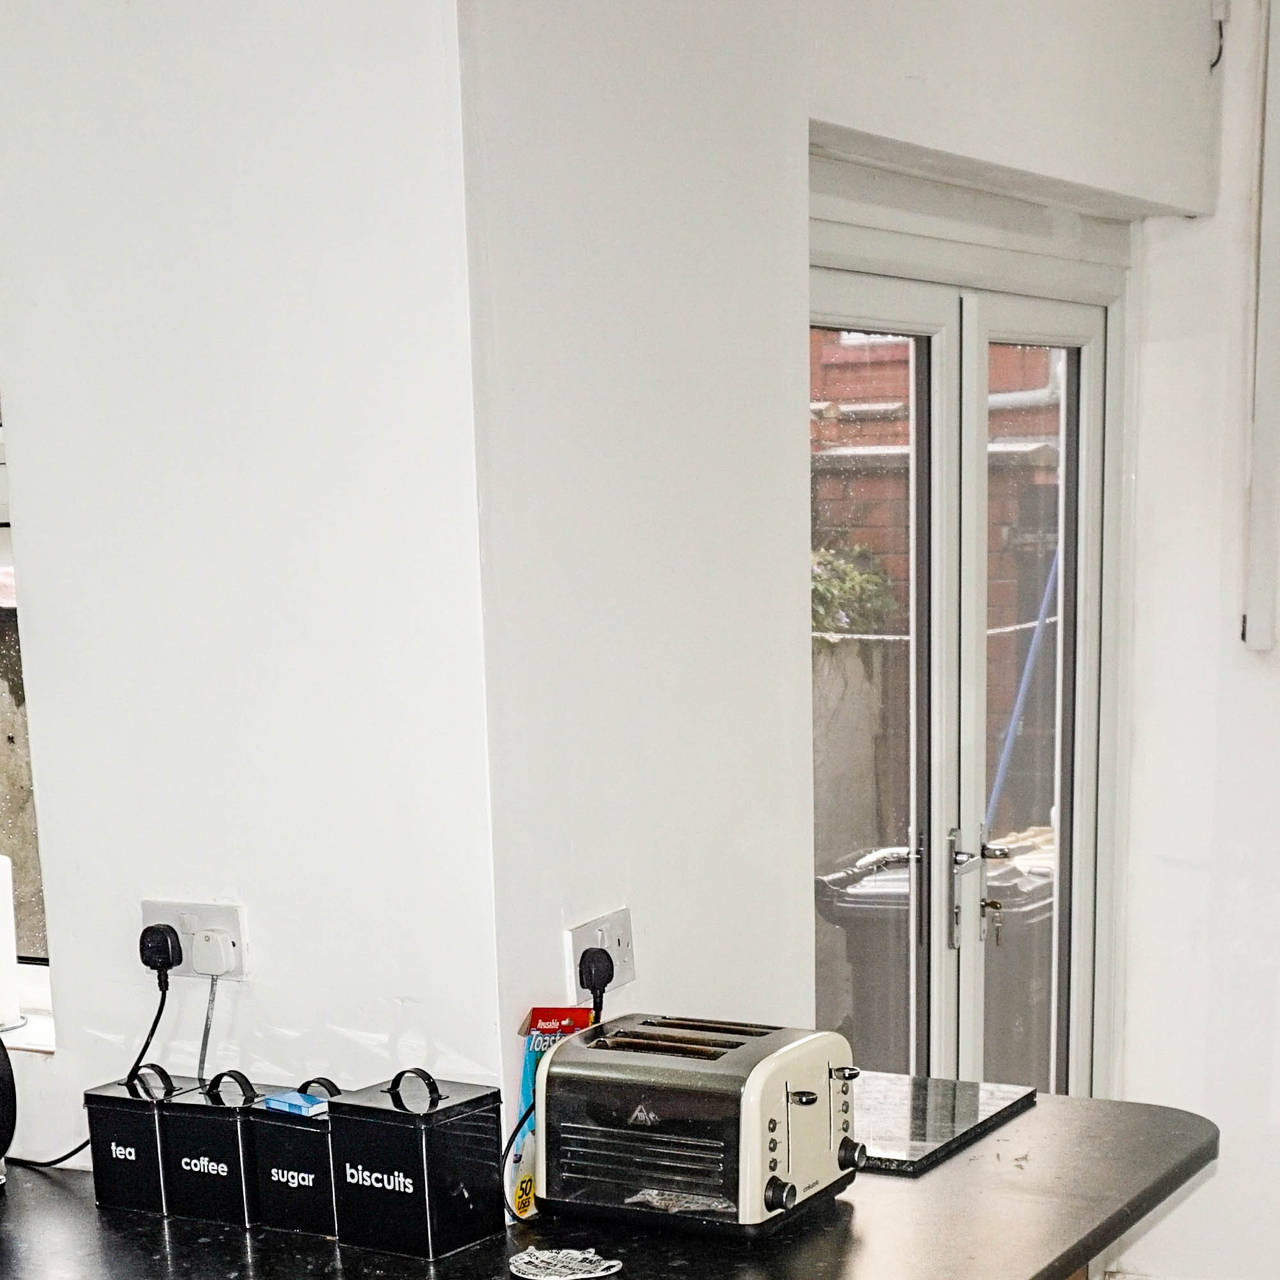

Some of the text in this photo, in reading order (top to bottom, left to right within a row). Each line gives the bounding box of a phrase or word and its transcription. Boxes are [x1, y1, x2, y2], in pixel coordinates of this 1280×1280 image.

[111, 1142, 136, 1160] tea
[181, 1157, 228, 1176] coffee
[271, 1168, 315, 1188] sugar
[345, 1162, 414, 1194] biscuits
[518, 1178, 533, 1199] 50
